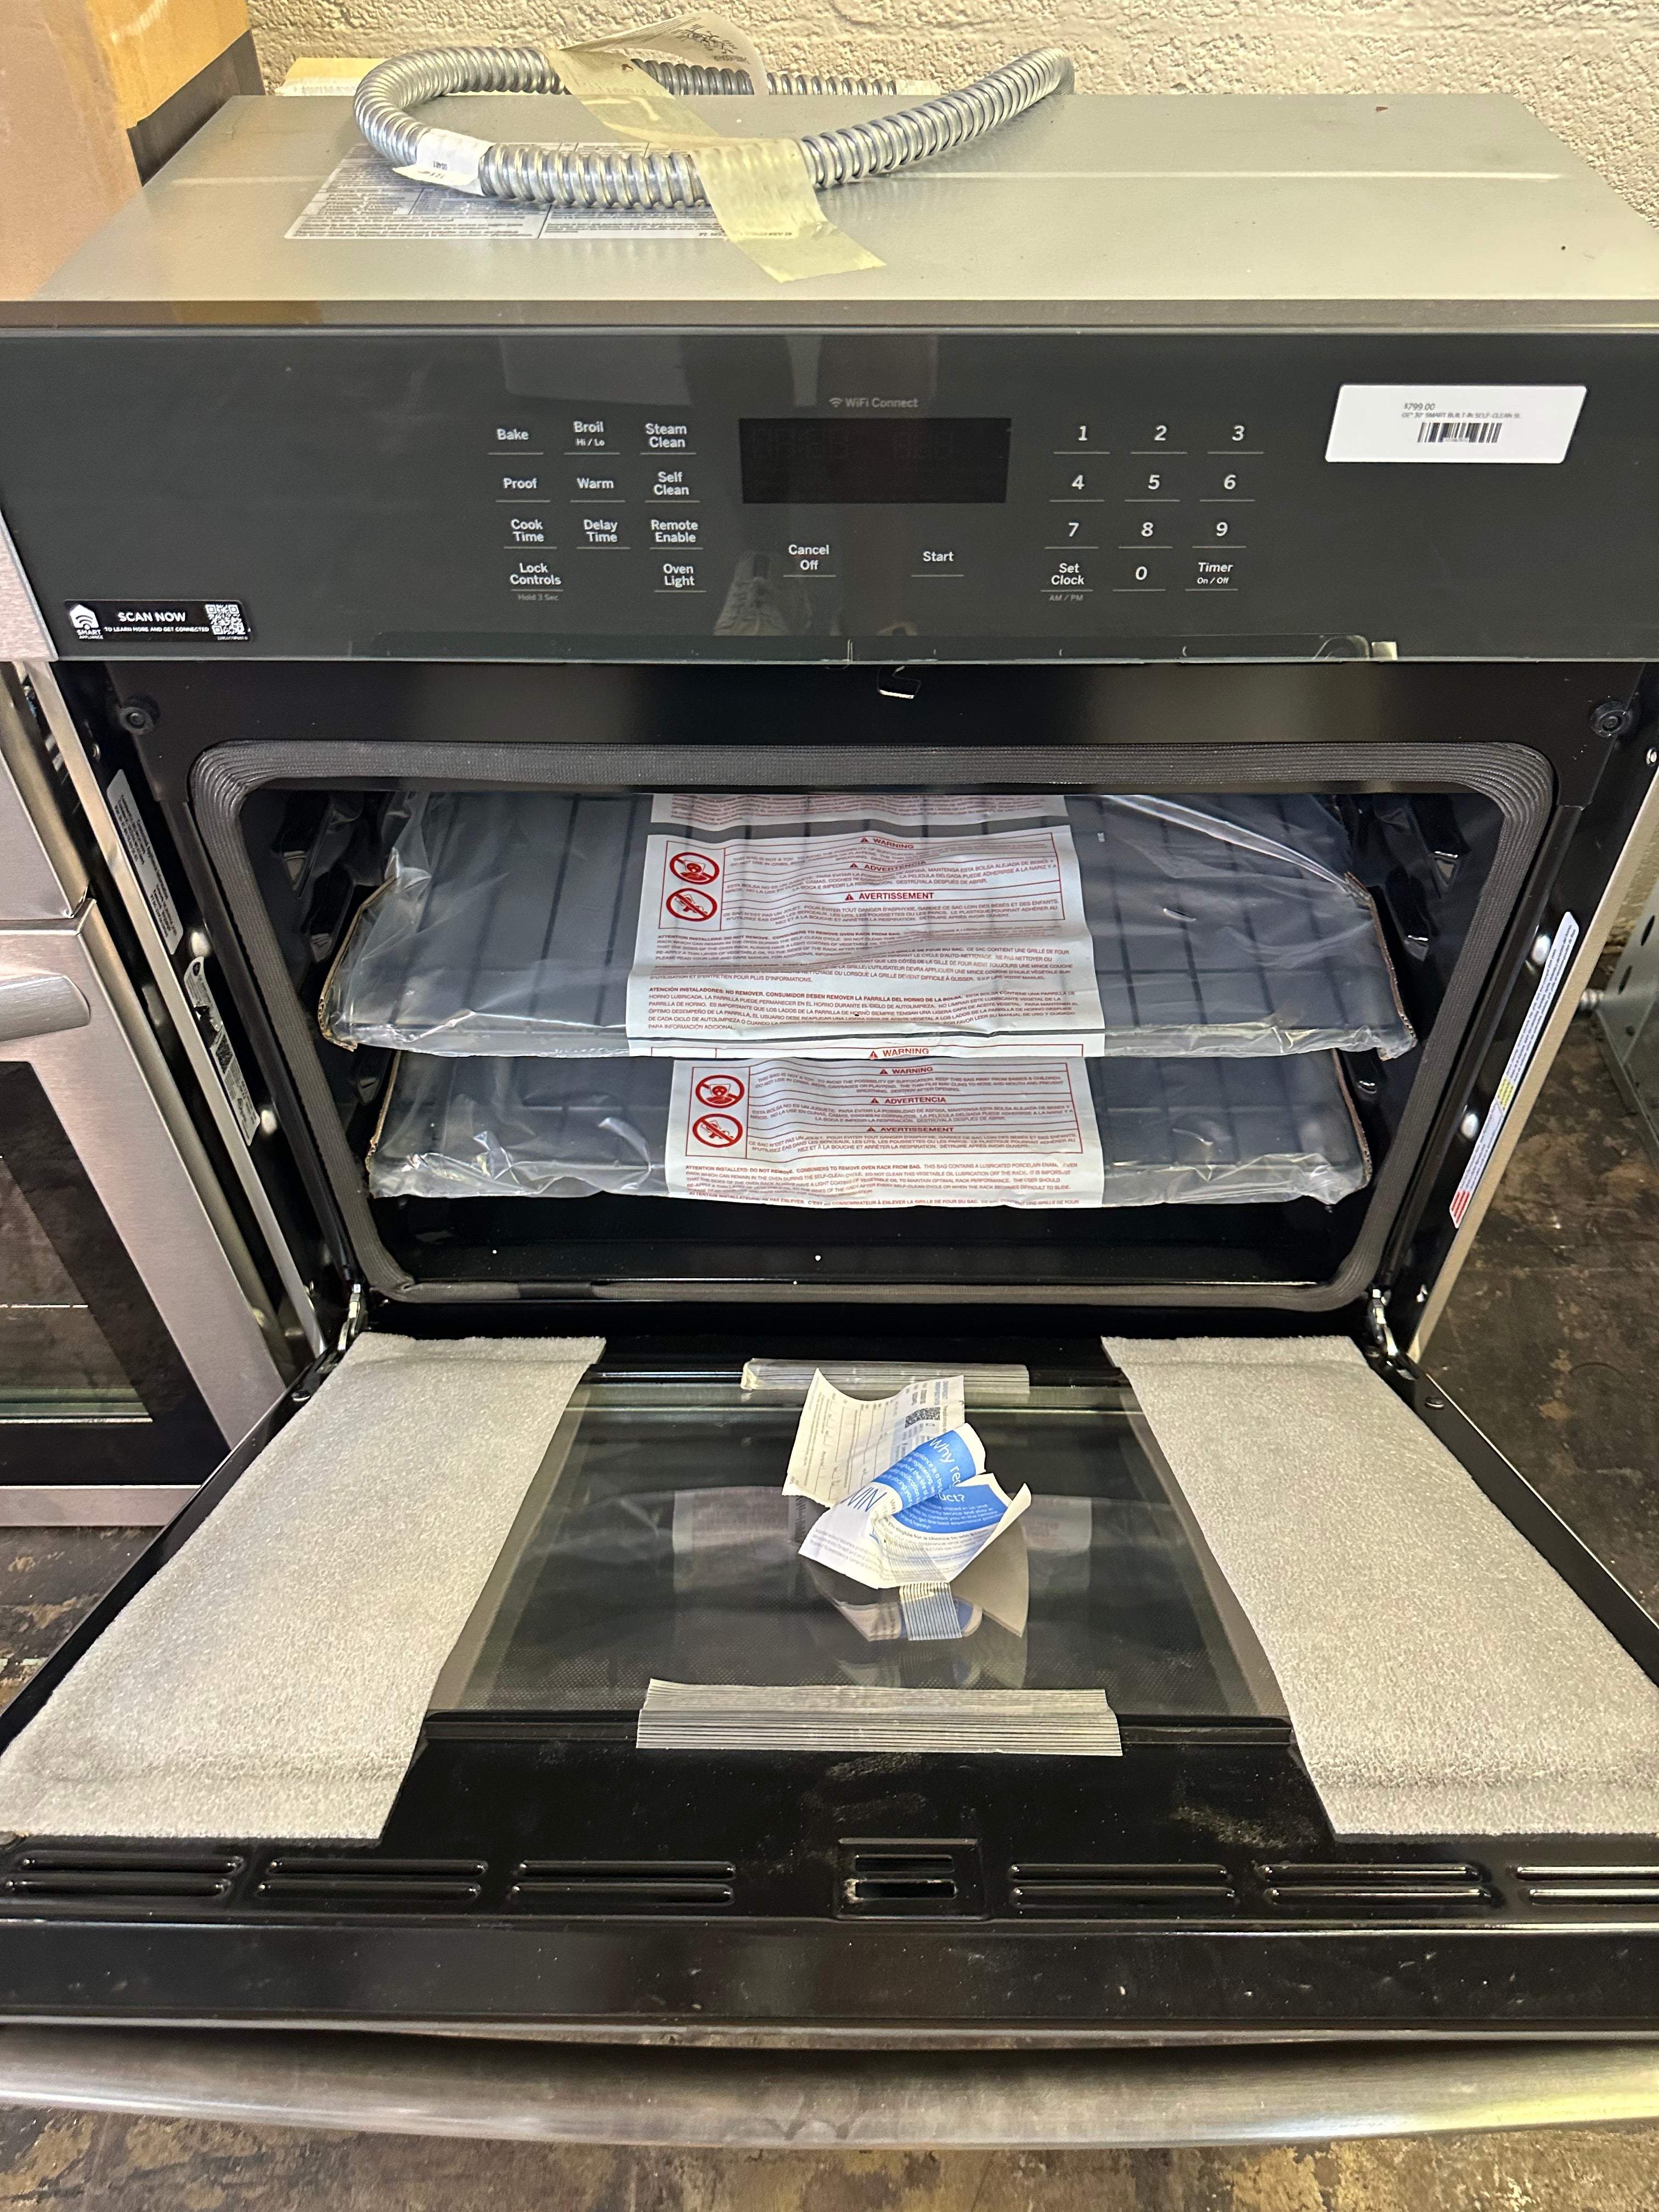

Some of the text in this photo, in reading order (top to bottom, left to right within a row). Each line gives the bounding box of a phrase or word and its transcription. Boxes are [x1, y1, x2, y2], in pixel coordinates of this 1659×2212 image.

[845, 398, 918, 408] WiFi Connect
[573, 421, 603, 433] Broil
[645, 423, 686, 435] Steam
[496, 428, 529, 441] Bake
[1078, 425, 1087, 441] 1
[1154, 425, 1167, 441] 2
[1232, 425, 1245, 441] 3
[649, 437, 686, 448] Clean
[658, 471, 683, 483] Self
[1071, 475, 1085, 489] 4
[1148, 475, 1160, 489] 5
[1223, 474, 1236, 489] 6
[504, 478, 537, 489] Proof
[577, 478, 614, 489] Warm
[653, 484, 689, 495] Clean
[511, 519, 543, 530] Cook
[584, 520, 618, 532] Delay
[651, 520, 698, 531] Remote
[1068, 522, 1079, 537] 7
[1141, 522, 1153, 537] 8
[1216, 522, 1228, 537] 9
[512, 532, 544, 542] Time
[586, 532, 618, 543] Time
[655, 532, 696, 543] Enable
[788, 544, 829, 556] Cancel
[923, 551, 953, 562] Start
[520, 563, 548, 573] Lock
[663, 563, 693, 574] Oven
[800, 560, 819, 571] Off
[1059, 563, 1079, 573] Set
[1198, 562, 1233, 573] Timer
[1135, 566, 1147, 580] 0
[510, 574, 561, 585] Controls
[664, 575, 695, 588] Light
[1051, 575, 1084, 585] Clock
[118, 612, 185, 622] SCAN NOW
[873, 838, 914, 849] WARNING
[865, 861, 927, 871] ADVERTENCIA
[883, 1048, 929, 1057] WARNING
[929, 1438, 955, 1463] Why
[912, 1470, 921, 1480] the
[904, 1489, 912, 1502] your
